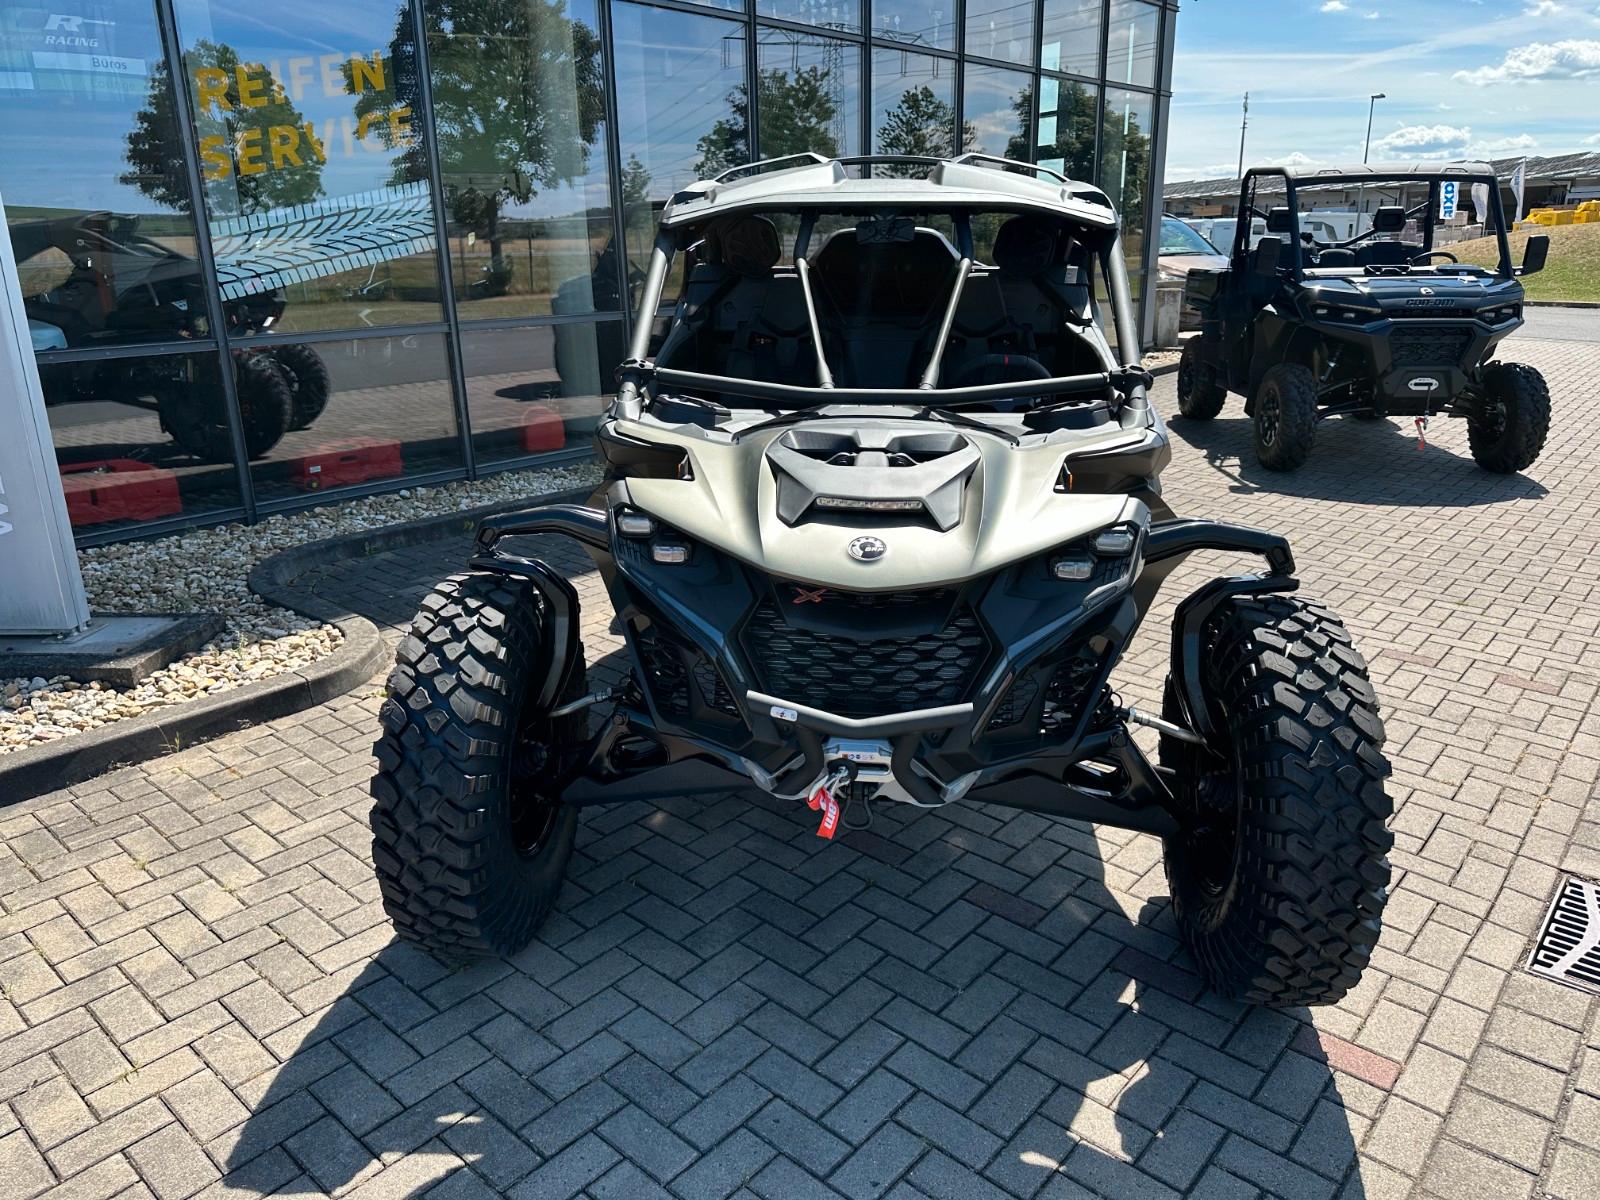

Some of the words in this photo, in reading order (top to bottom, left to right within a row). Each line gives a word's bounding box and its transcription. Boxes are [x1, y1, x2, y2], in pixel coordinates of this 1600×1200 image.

[45, 35, 99, 48] RACING
[91, 57, 128, 70] Büros
[195, 50, 386, 112] REIFEN
[200, 107, 413, 181] SERVICE
